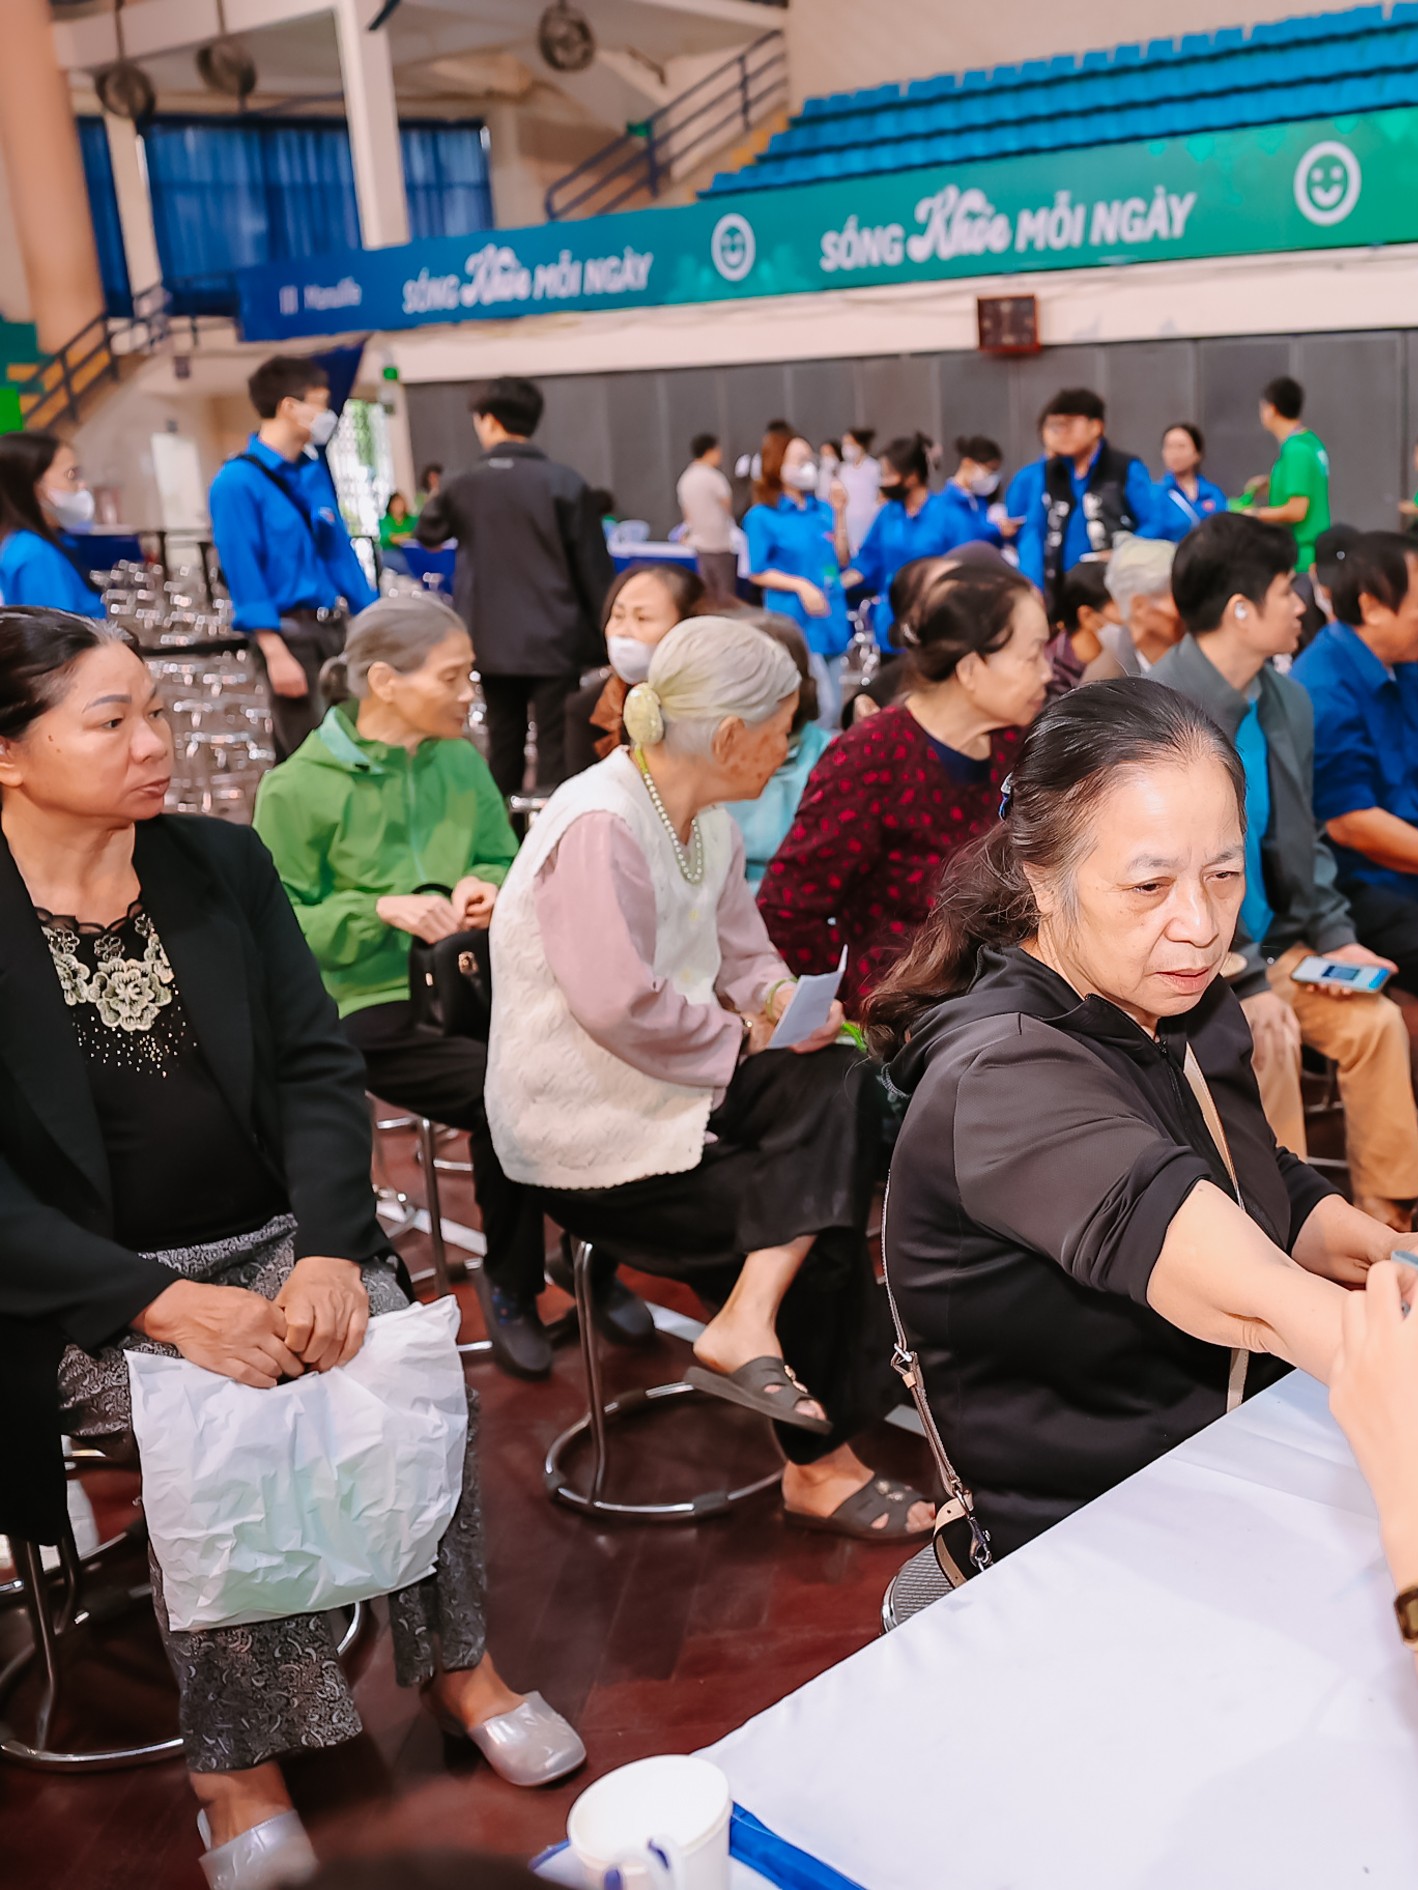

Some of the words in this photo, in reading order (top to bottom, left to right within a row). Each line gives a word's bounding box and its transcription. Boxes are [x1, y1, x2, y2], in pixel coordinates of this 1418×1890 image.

[820, 214, 905, 272] SỐNG
[1089, 184, 1198, 246] NGÀY
[583, 246, 654, 295] NGÀY
